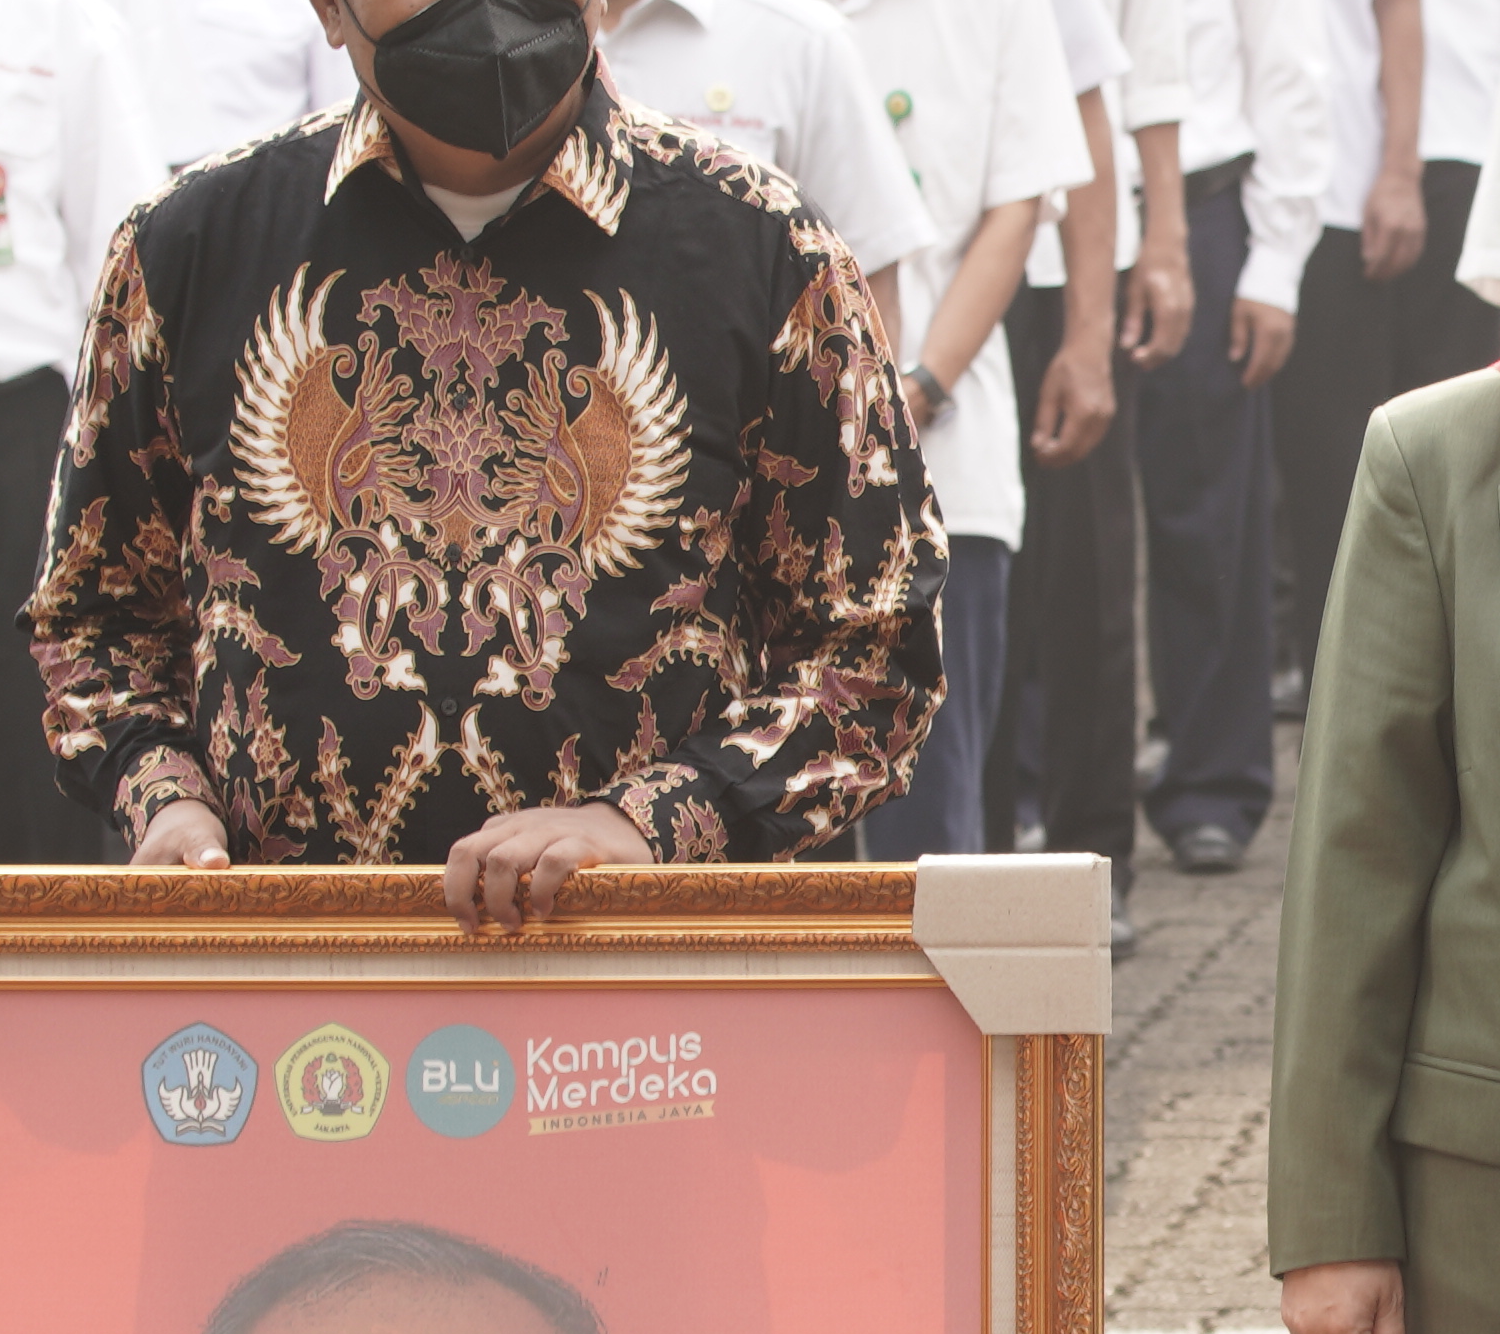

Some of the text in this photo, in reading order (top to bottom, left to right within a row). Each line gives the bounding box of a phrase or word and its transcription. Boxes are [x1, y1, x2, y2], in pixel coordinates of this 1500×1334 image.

[526, 1030, 703, 1078] Kampus
[422, 1059, 500, 1094] BLU
[526, 1062, 718, 1114] Merdeka
[542, 1103, 705, 1133] INDONESIA JAYA
